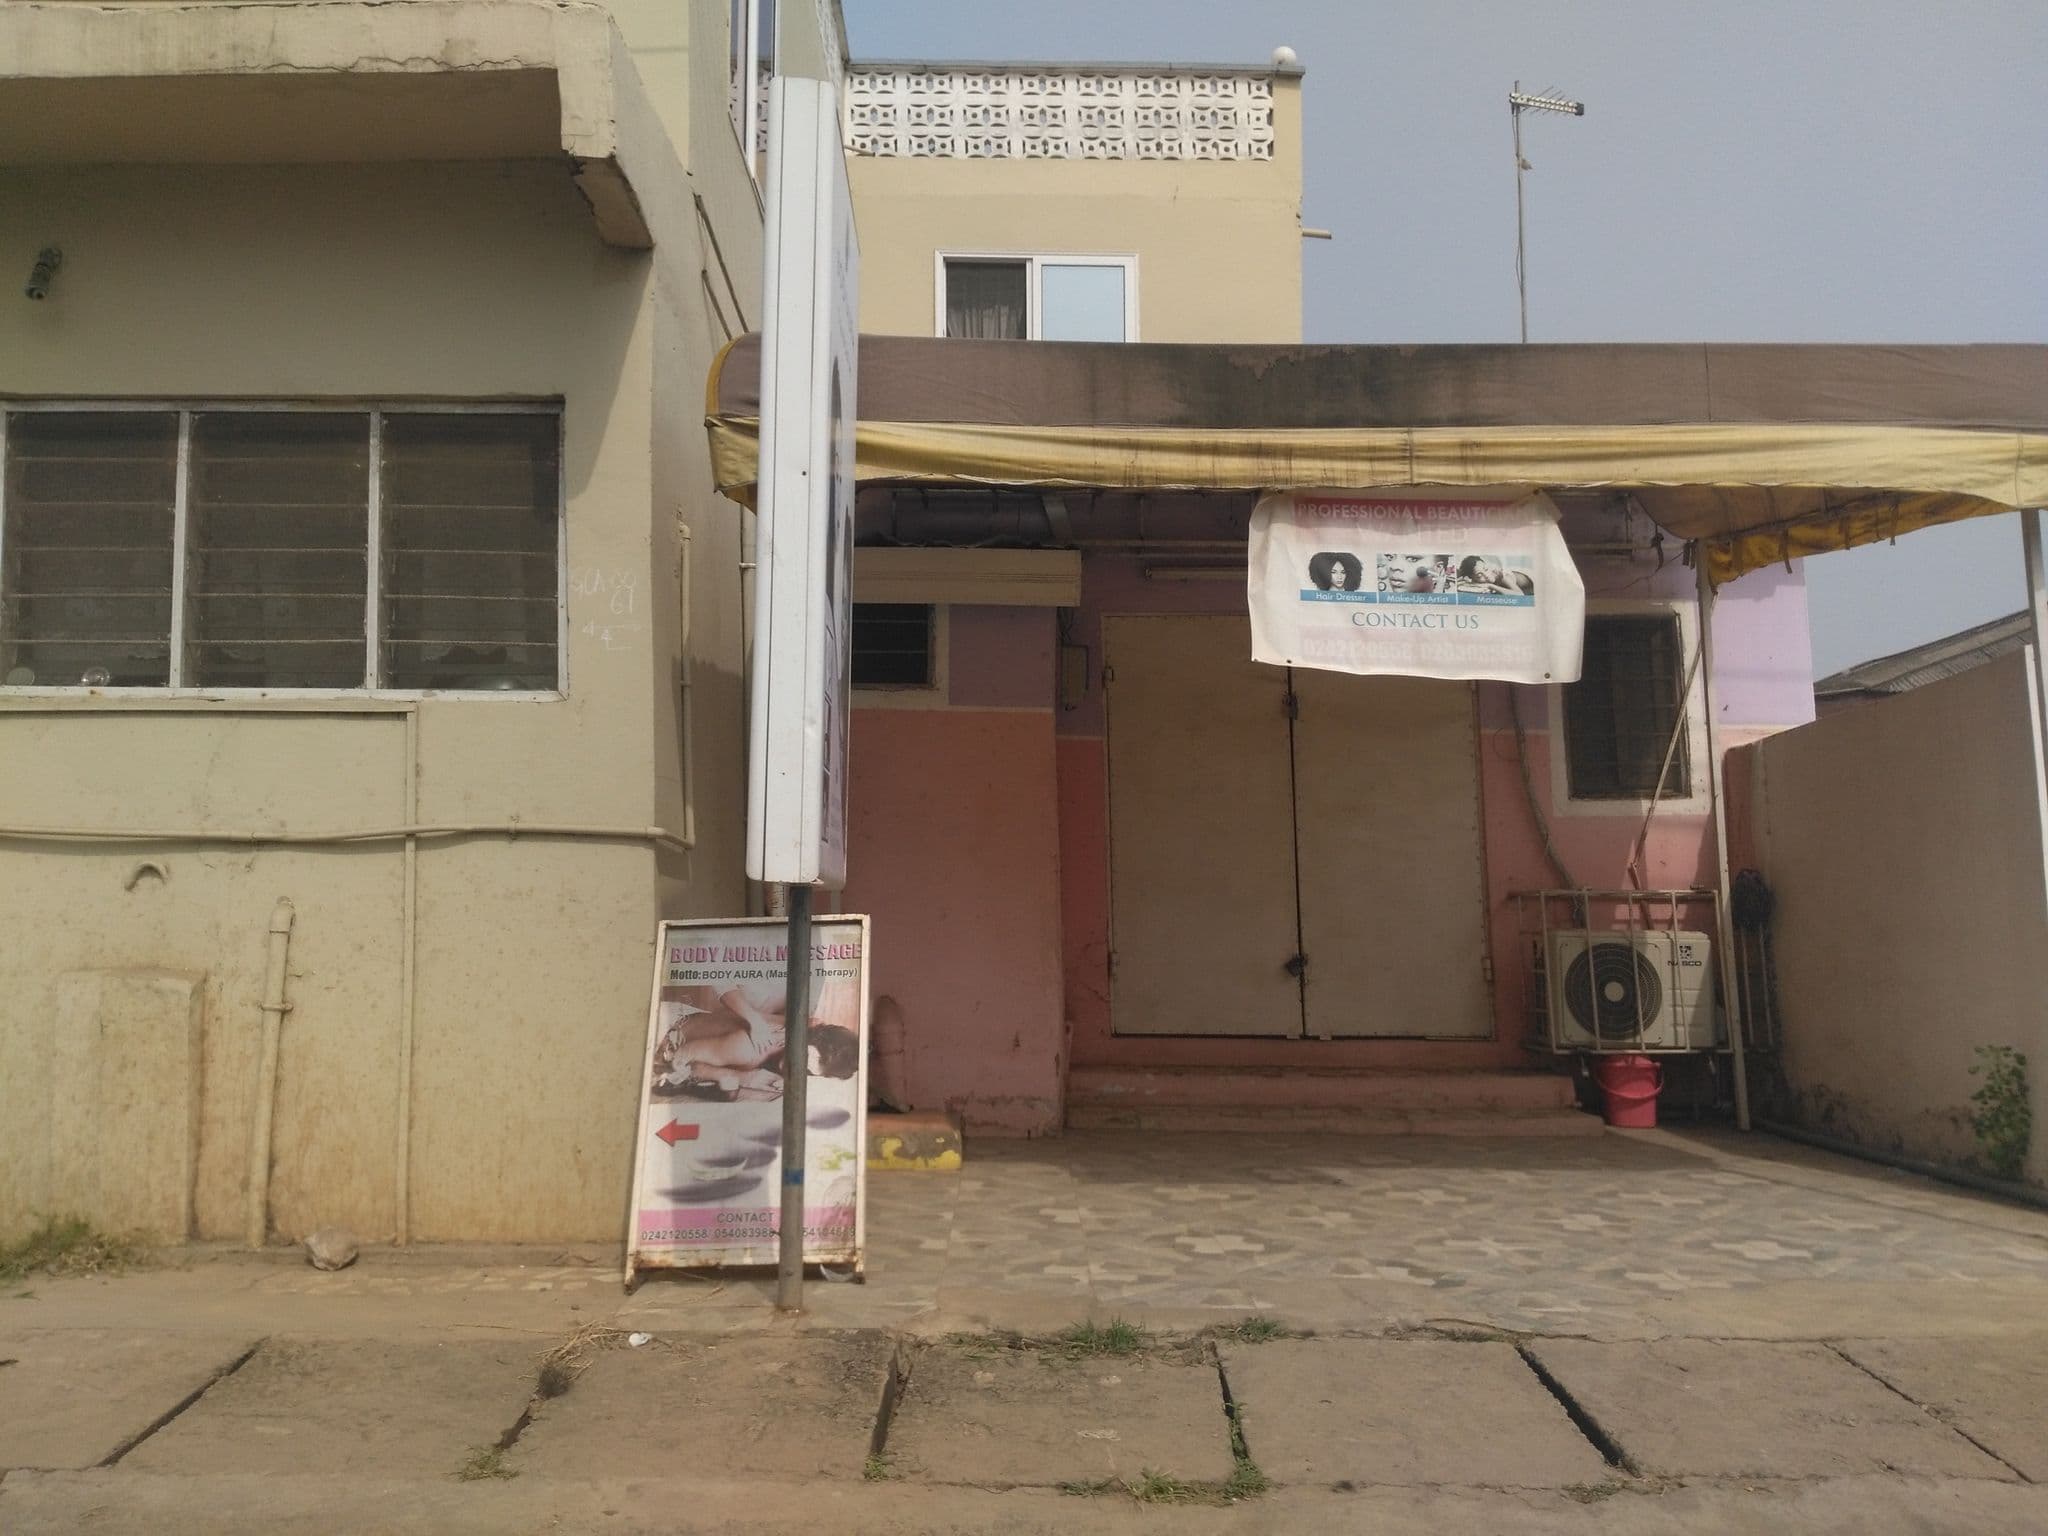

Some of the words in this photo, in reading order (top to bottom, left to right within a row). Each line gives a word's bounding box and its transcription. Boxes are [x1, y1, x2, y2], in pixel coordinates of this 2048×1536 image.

[1298, 503, 1422, 520] PROFESSIONAL
[1315, 592, 1332, 601] Hair
[1336, 593, 1366, 602] Dresser
[1386, 594, 1425, 604] Make-Up
[1428, 595, 1448, 604] Artist
[1477, 595, 1517, 605] Masseuse
[1352, 611, 1448, 629] CONTACT
[1456, 614, 1479, 630] US
[670, 945, 718, 963] BODY
[722, 945, 772, 963] AURA
[775, 944, 862, 962] MSSAGE
[670, 969, 701, 980] Motto:
[702, 970, 732, 980] BODY
[734, 970, 763, 979] AURA
[815, 967, 857, 979] Therapy)
[716, 1212, 774, 1223] CONTACT
[641, 1229, 707, 1240] 0242120558
